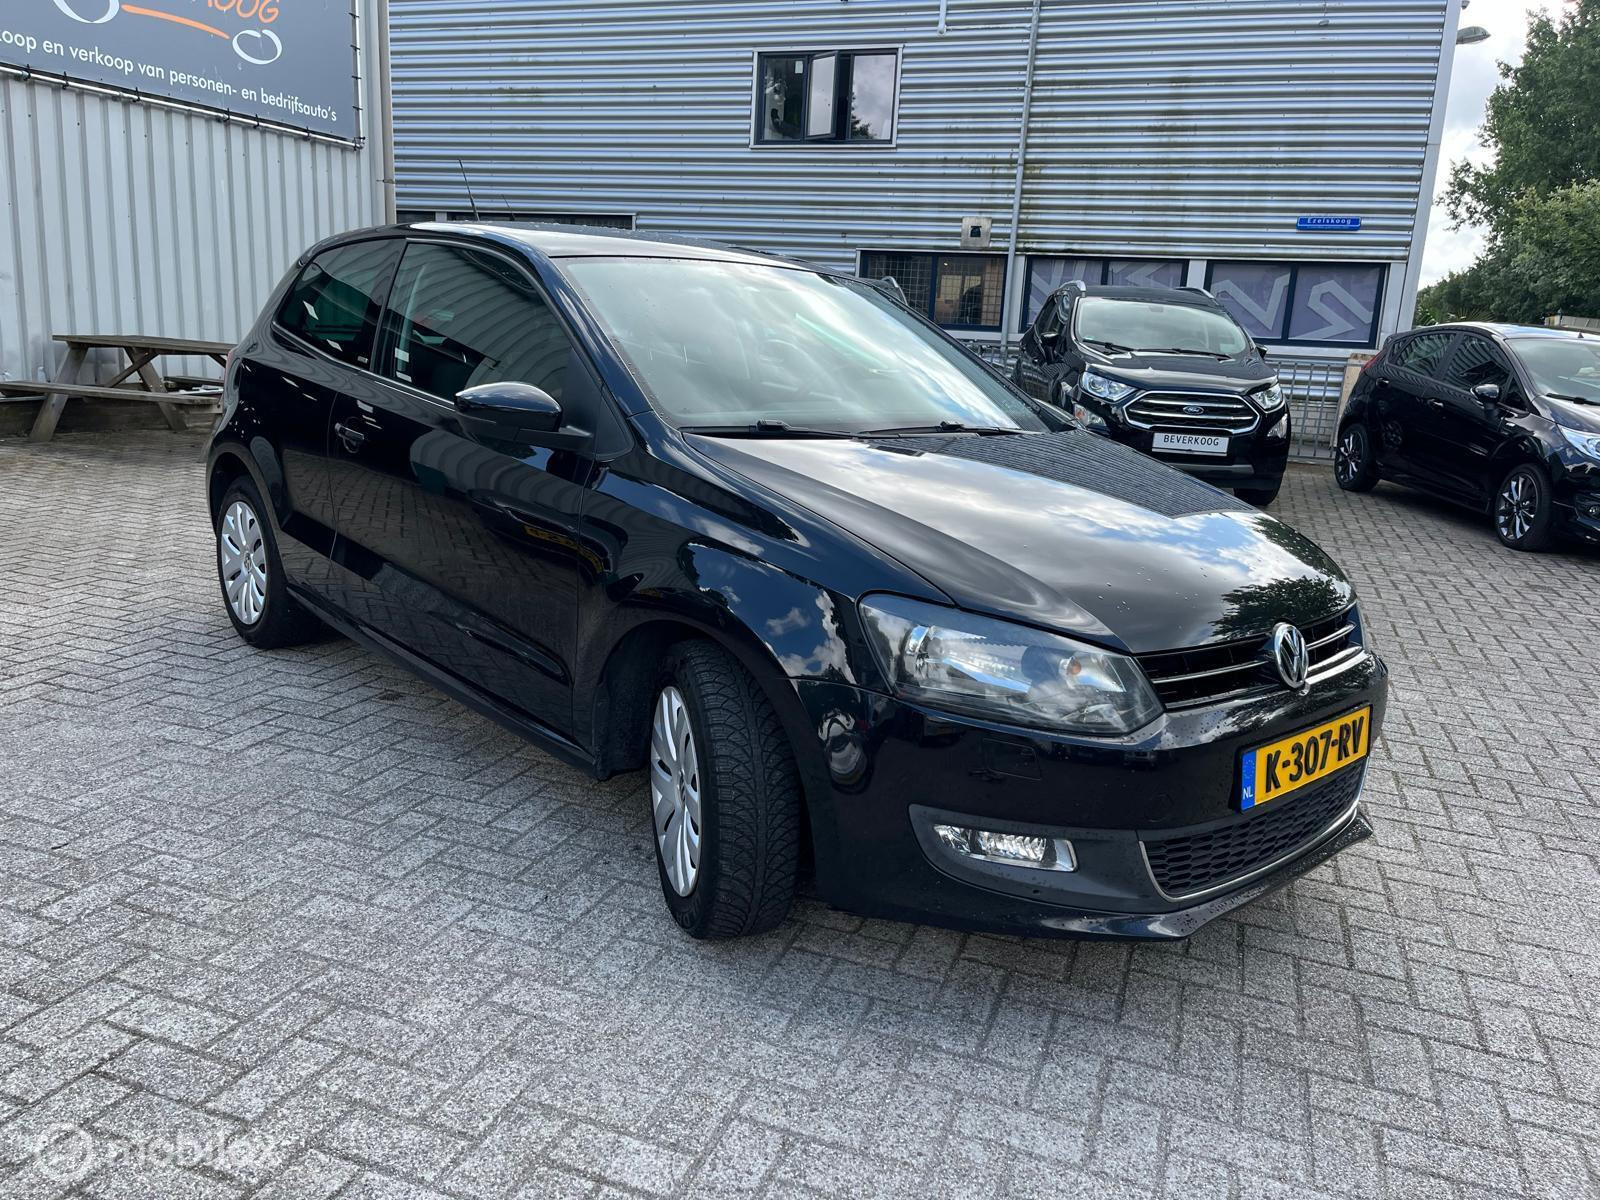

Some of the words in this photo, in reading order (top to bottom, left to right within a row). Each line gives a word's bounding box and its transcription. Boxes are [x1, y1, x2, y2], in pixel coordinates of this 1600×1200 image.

[0, 30, 37, 53] oop
[42, 40, 64, 56] en
[69, 46, 134, 75] verkoop
[138, 63, 165, 79] van
[169, 70, 237, 96] personen-
[241, 88, 257, 101] en
[1163, 434, 1219, 446] BEVERKOOG
[1265, 716, 1364, 794] K-307-RV
[1242, 786, 1254, 799] NL
